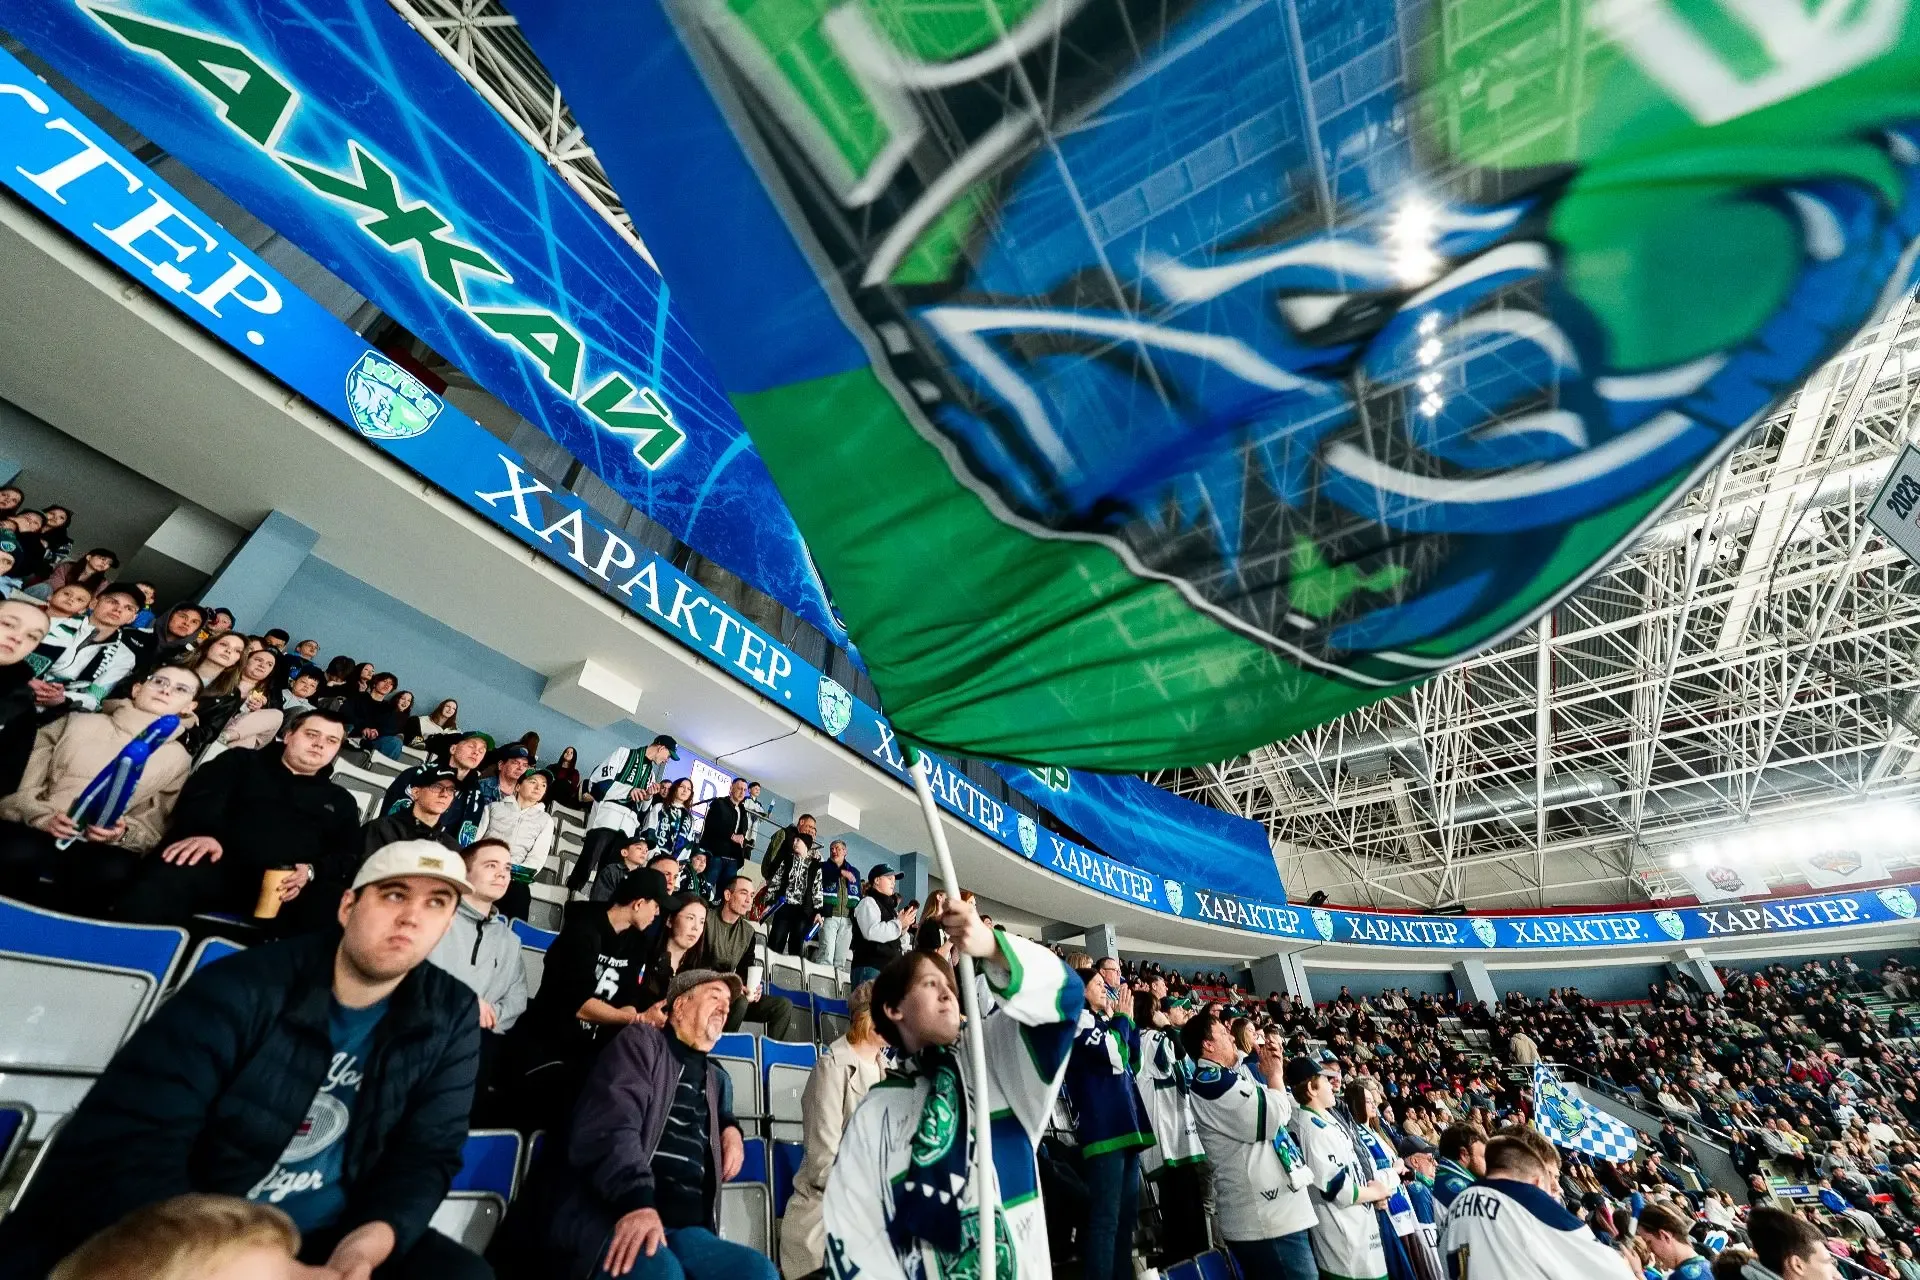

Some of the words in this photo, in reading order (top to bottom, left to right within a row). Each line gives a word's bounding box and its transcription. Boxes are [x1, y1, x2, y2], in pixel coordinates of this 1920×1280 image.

[0, 83, 283, 346] ТЕР.
[475, 453, 793, 700] ХАРАКТЕР.
[872, 719, 1007, 838] ХРАКТЕР.
[1050, 836, 1157, 905] ХАРАКТЕР.
[1194, 891, 1305, 935] ХАРАКТЕР.
[1344, 916, 1465, 945] ХАРАКТЕР.
[1509, 917, 1649, 944] ХАРАКТЕР.
[1698, 898, 1871, 934] ХАРАКТЕР.
